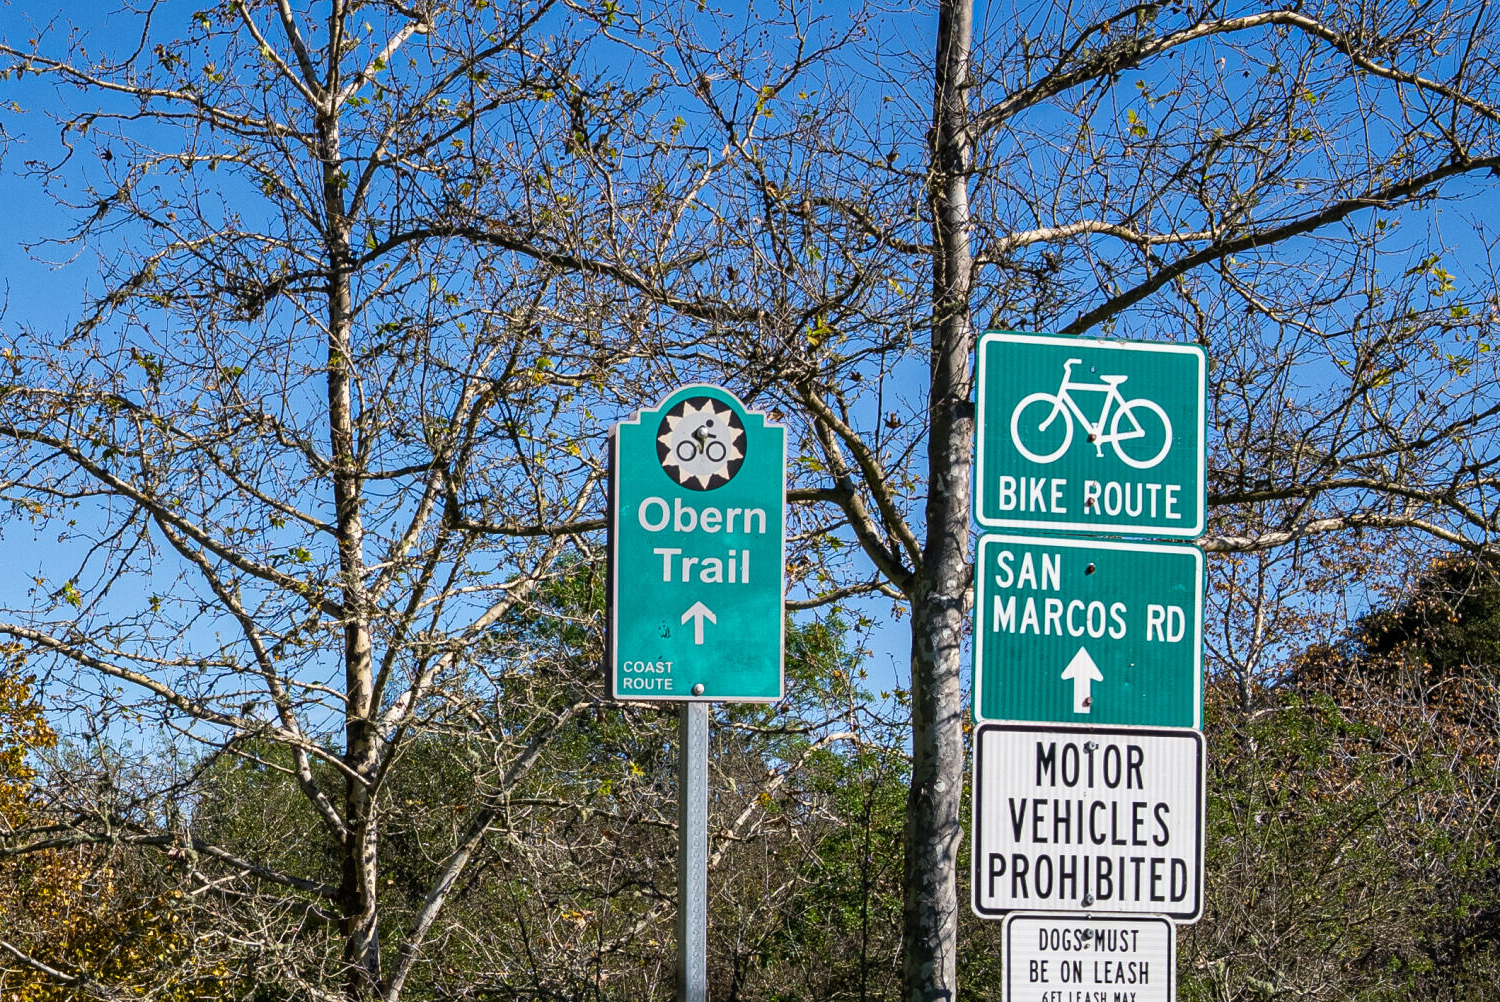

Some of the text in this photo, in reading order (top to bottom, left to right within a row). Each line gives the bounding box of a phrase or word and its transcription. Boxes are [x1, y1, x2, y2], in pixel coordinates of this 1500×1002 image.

[638, 497, 766, 534] Obern
[999, 476, 1181, 519] BIKE ROUTE
[653, 548, 750, 583] Trail
[995, 551, 1061, 591] SAN
[993, 595, 1186, 643] MARCOS RD
[623, 661, 673, 674] COAST
[623, 678, 673, 690] ROUTE
[1036, 741, 1144, 789] MOTOR
[1008, 798, 1170, 847] VEHICLES
[988, 853, 1187, 903] PROHIBITED
[1039, 928, 1139, 952] DOGS MUST
[1029, 960, 1149, 984] BE ON LEASH
